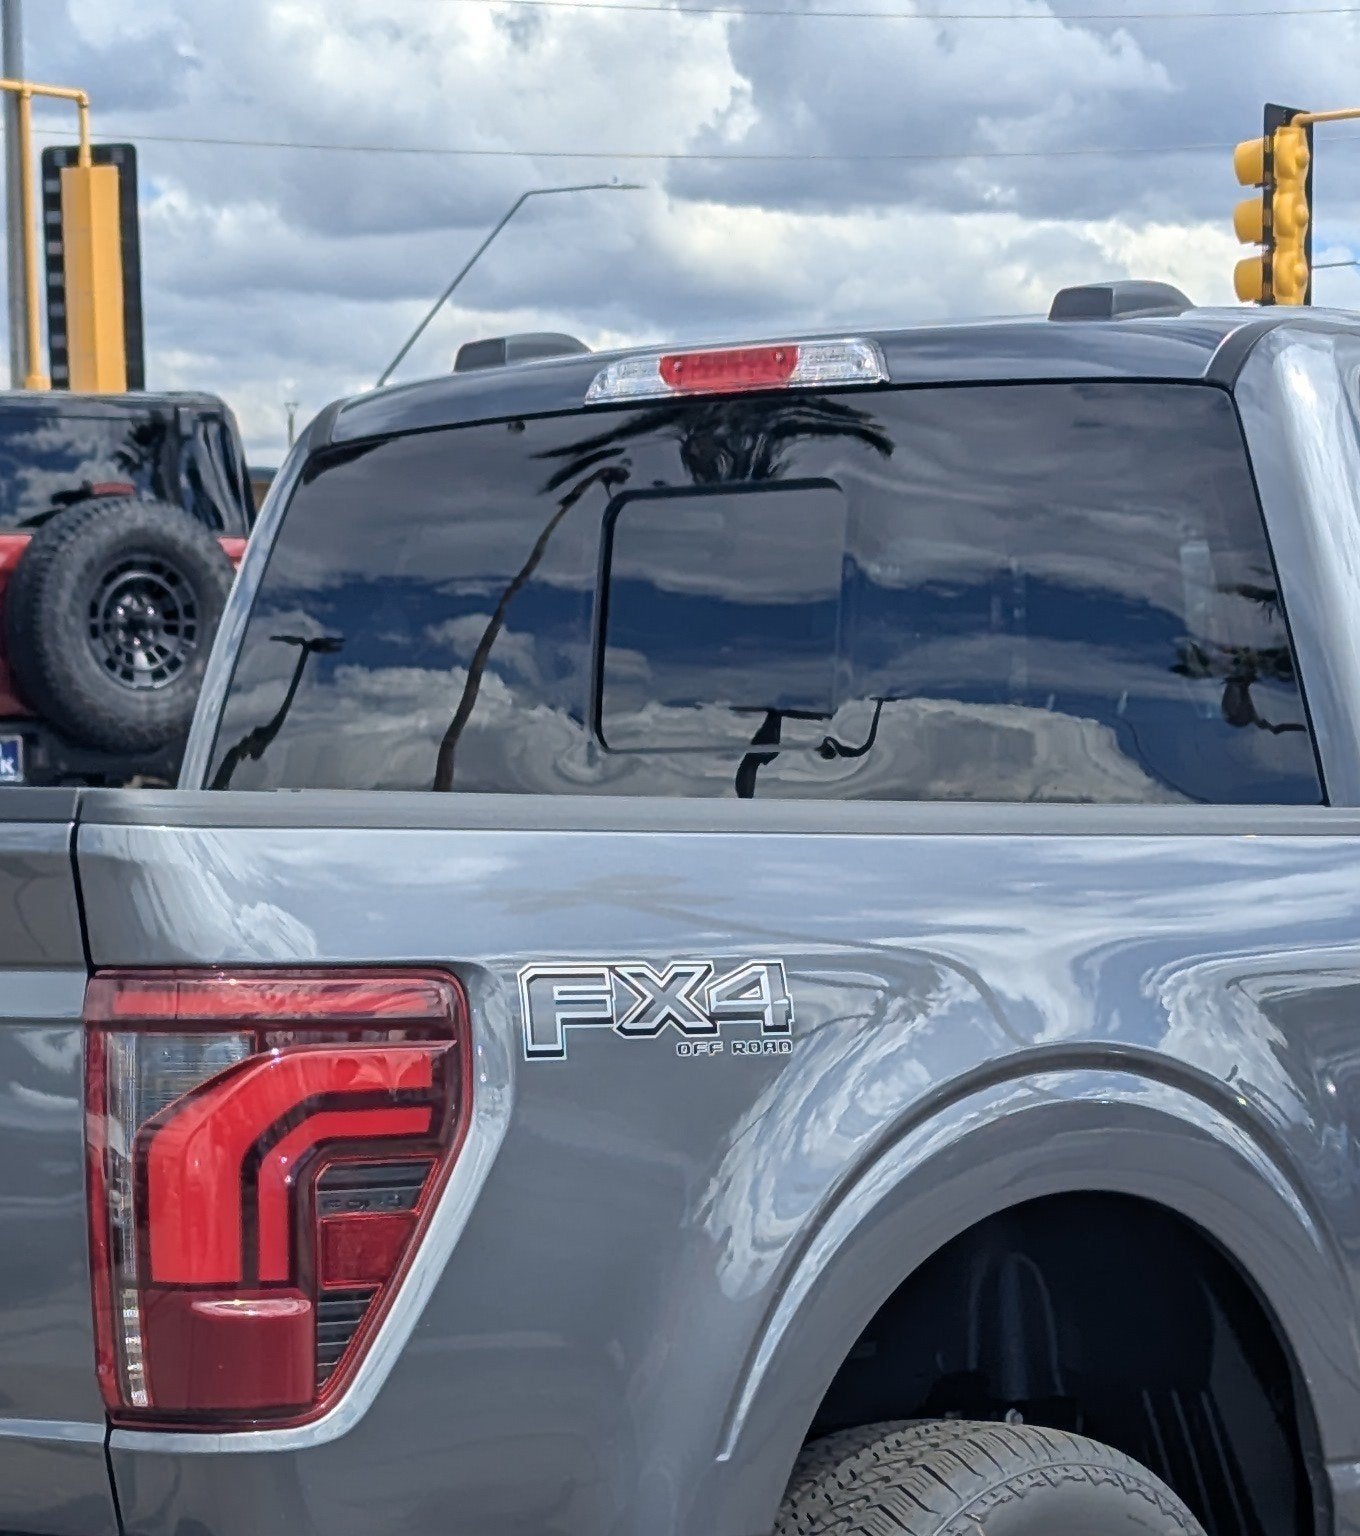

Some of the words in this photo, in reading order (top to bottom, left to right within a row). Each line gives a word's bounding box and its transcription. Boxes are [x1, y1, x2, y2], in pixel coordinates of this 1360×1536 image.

[517, 959, 794, 1061] FX4
[676, 1041, 723, 1057] OFF
[731, 1039, 793, 1056] ROAD
